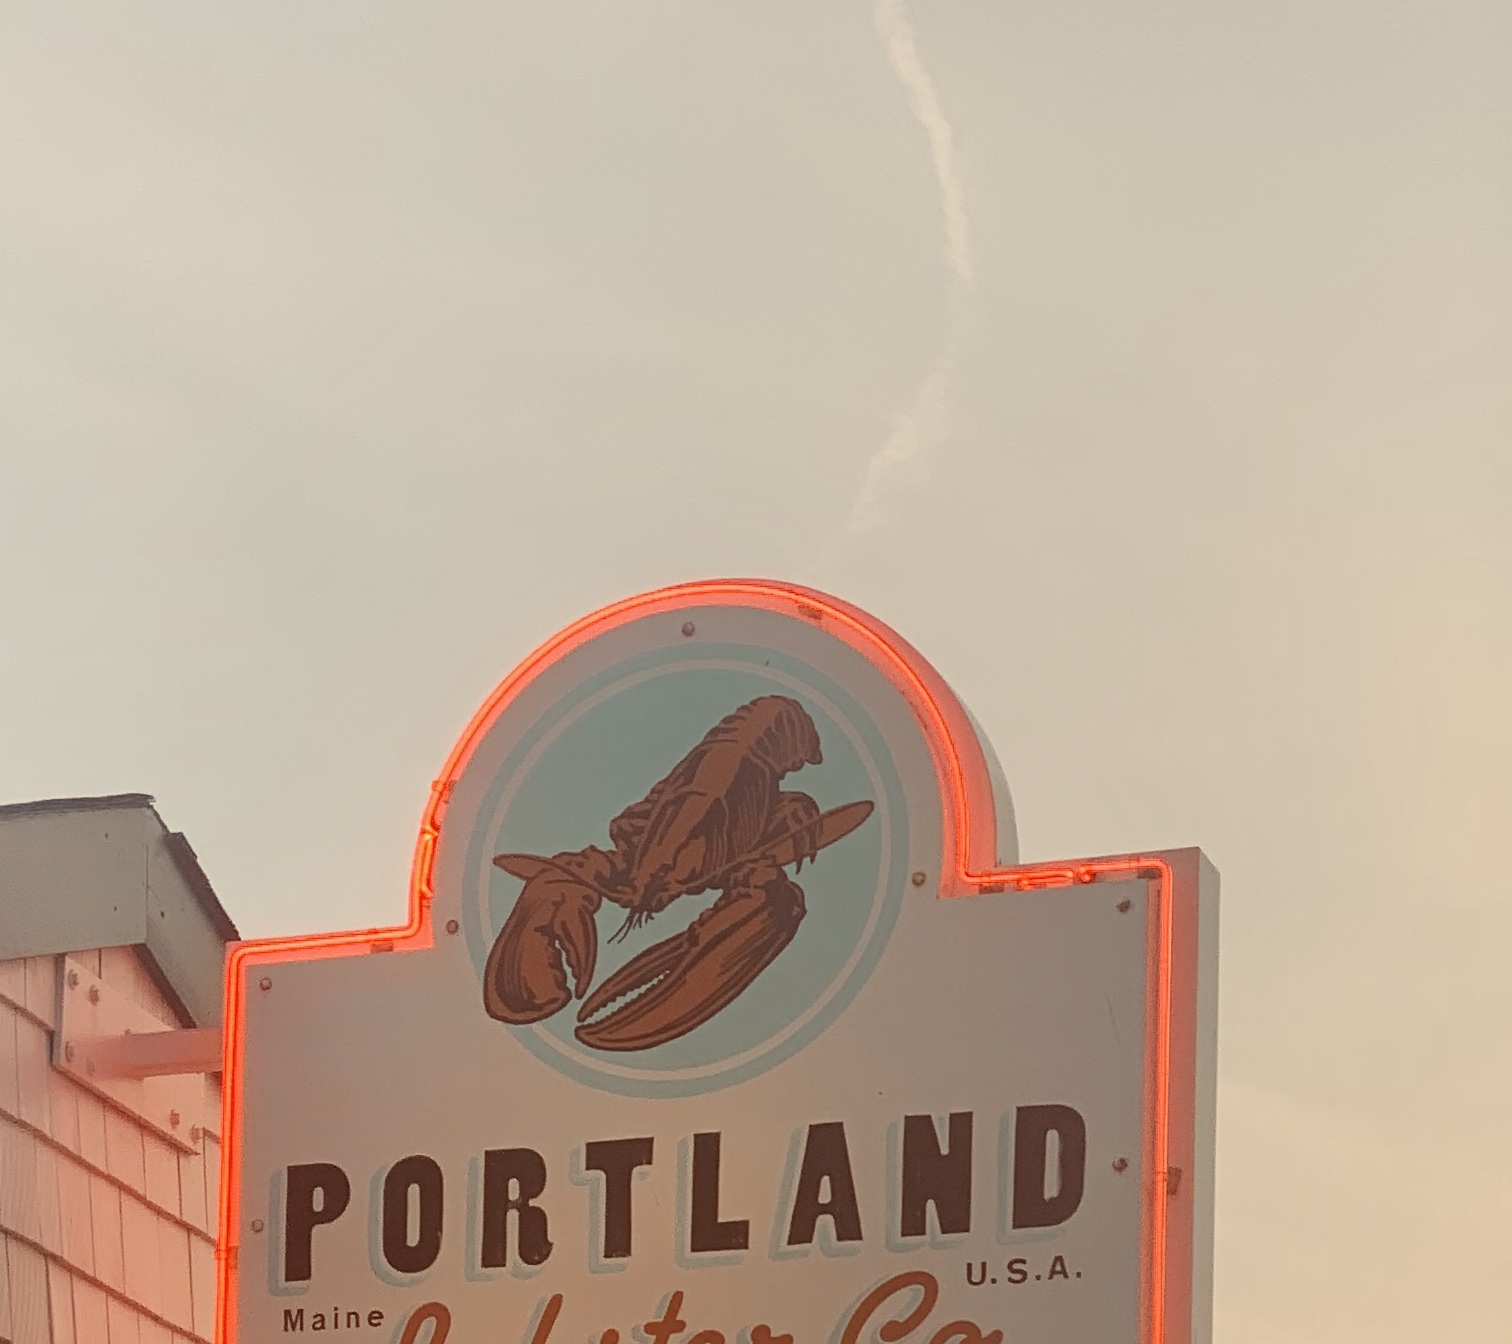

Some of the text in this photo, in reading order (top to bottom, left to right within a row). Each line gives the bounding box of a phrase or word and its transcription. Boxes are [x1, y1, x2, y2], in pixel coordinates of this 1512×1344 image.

[282, 1103, 1088, 1283] PORTLAND
[964, 1260, 1084, 1288] U.S.A.
[282, 1304, 386, 1334] Maine
